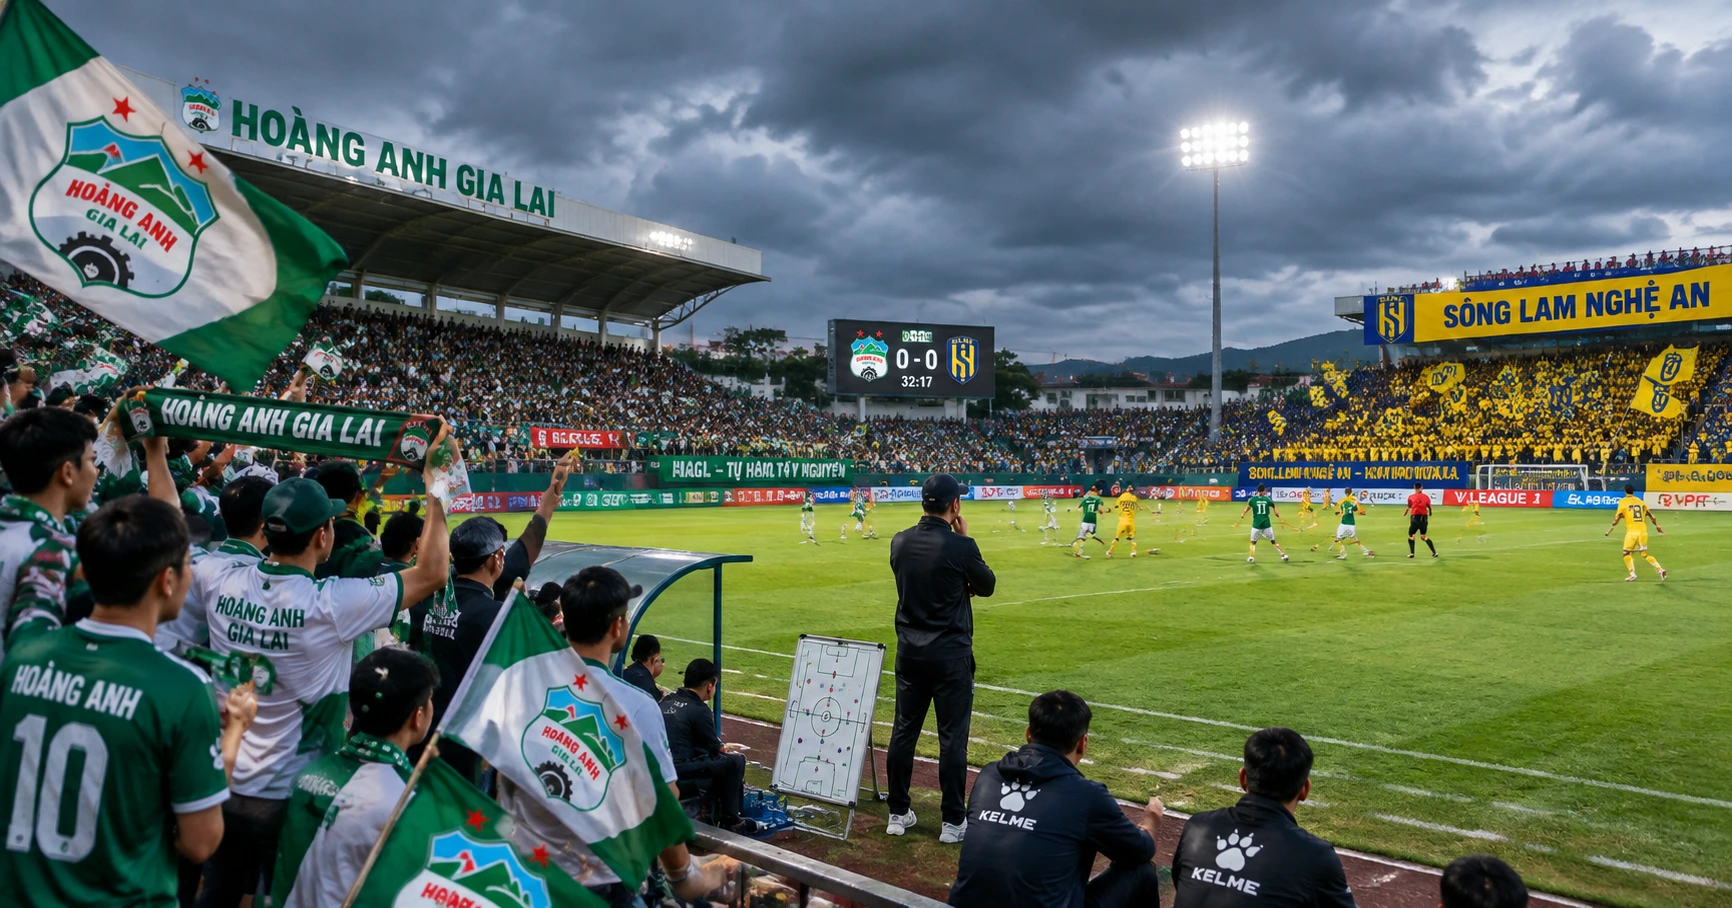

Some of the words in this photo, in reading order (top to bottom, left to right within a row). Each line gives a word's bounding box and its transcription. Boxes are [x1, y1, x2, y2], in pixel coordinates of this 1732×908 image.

[231, 99, 365, 167] HOÀNG
[375, 141, 447, 190] ANH
[456, 164, 505, 206] GIA
[514, 180, 555, 218] LAI
[86, 208, 117, 233] GIA
[119, 224, 148, 250] LAI
[137, 212, 178, 253] ANH
[1443, 297, 1511, 328] SÔNG
[1519, 294, 1576, 323] LAM
[1669, 281, 1710, 310] AN
[896, 348, 909, 370] 0
[925, 348, 938, 370] 0
[901, 376, 933, 388] 32:17
[237, 406, 290, 437] ANH
[291, 411, 333, 442] GIA
[339, 417, 386, 447] LAI
[268, 607, 305, 628] ANH
[227, 622, 255, 646] GIA
[260, 629, 289, 650] LAI
[83, 680, 143, 721] ANH
[578, 751, 600, 781] ANH
[5, 713, 109, 864] 10
[978, 810, 1037, 831] KELME
[1191, 866, 1260, 896] KELME
